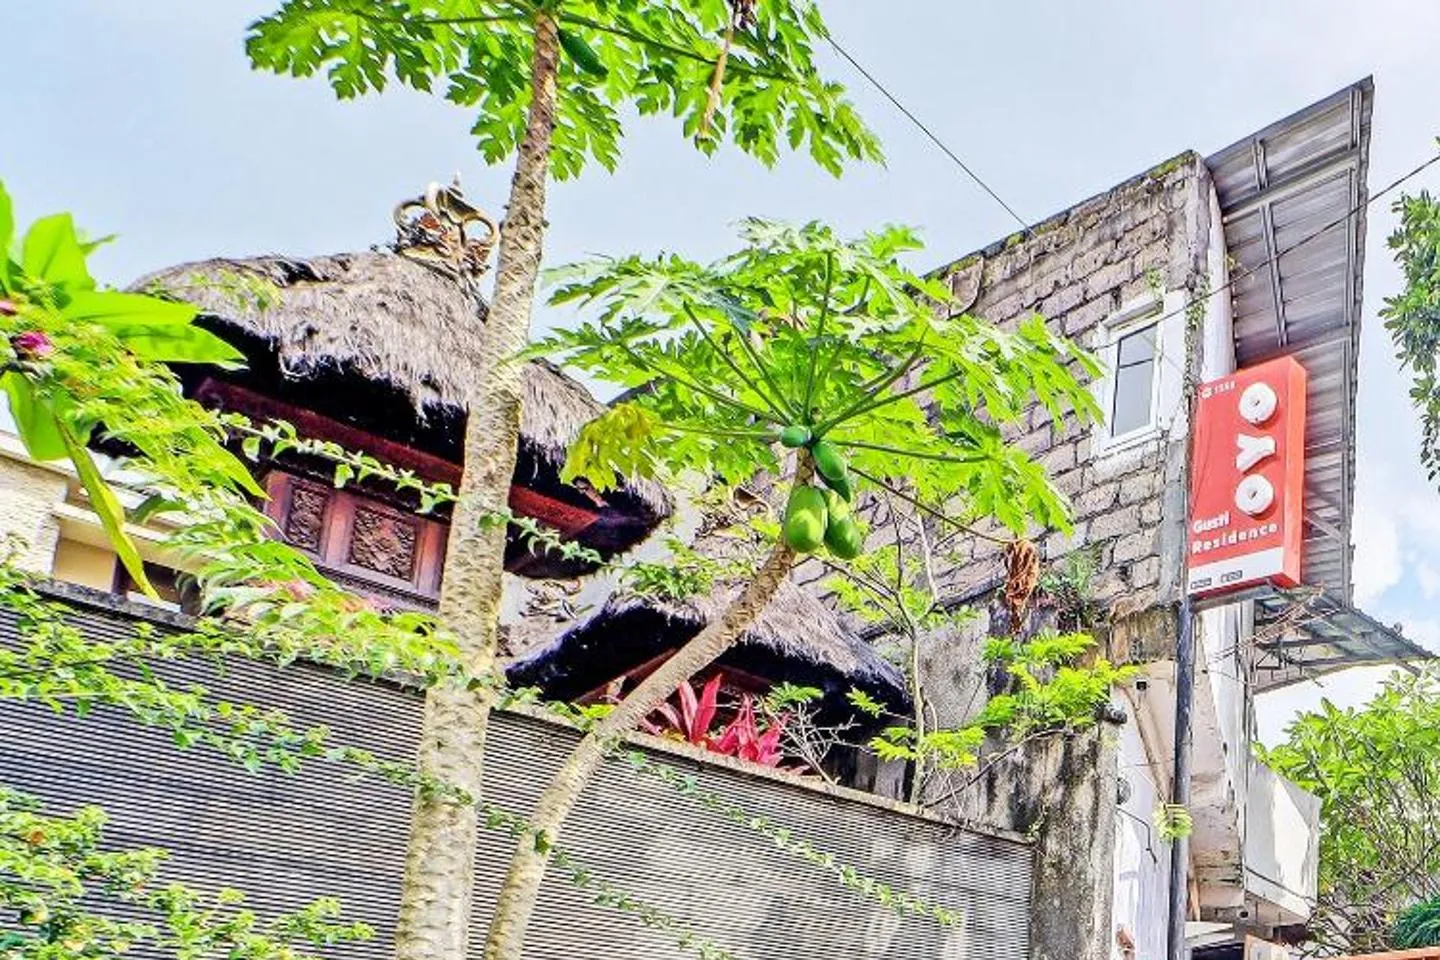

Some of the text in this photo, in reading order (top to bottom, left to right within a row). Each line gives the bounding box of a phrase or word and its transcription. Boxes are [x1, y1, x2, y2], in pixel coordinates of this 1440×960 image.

[1235, 381, 1278, 515] OYO
[1192, 511, 1231, 533] Gusti
[1191, 523, 1278, 554] Residence
